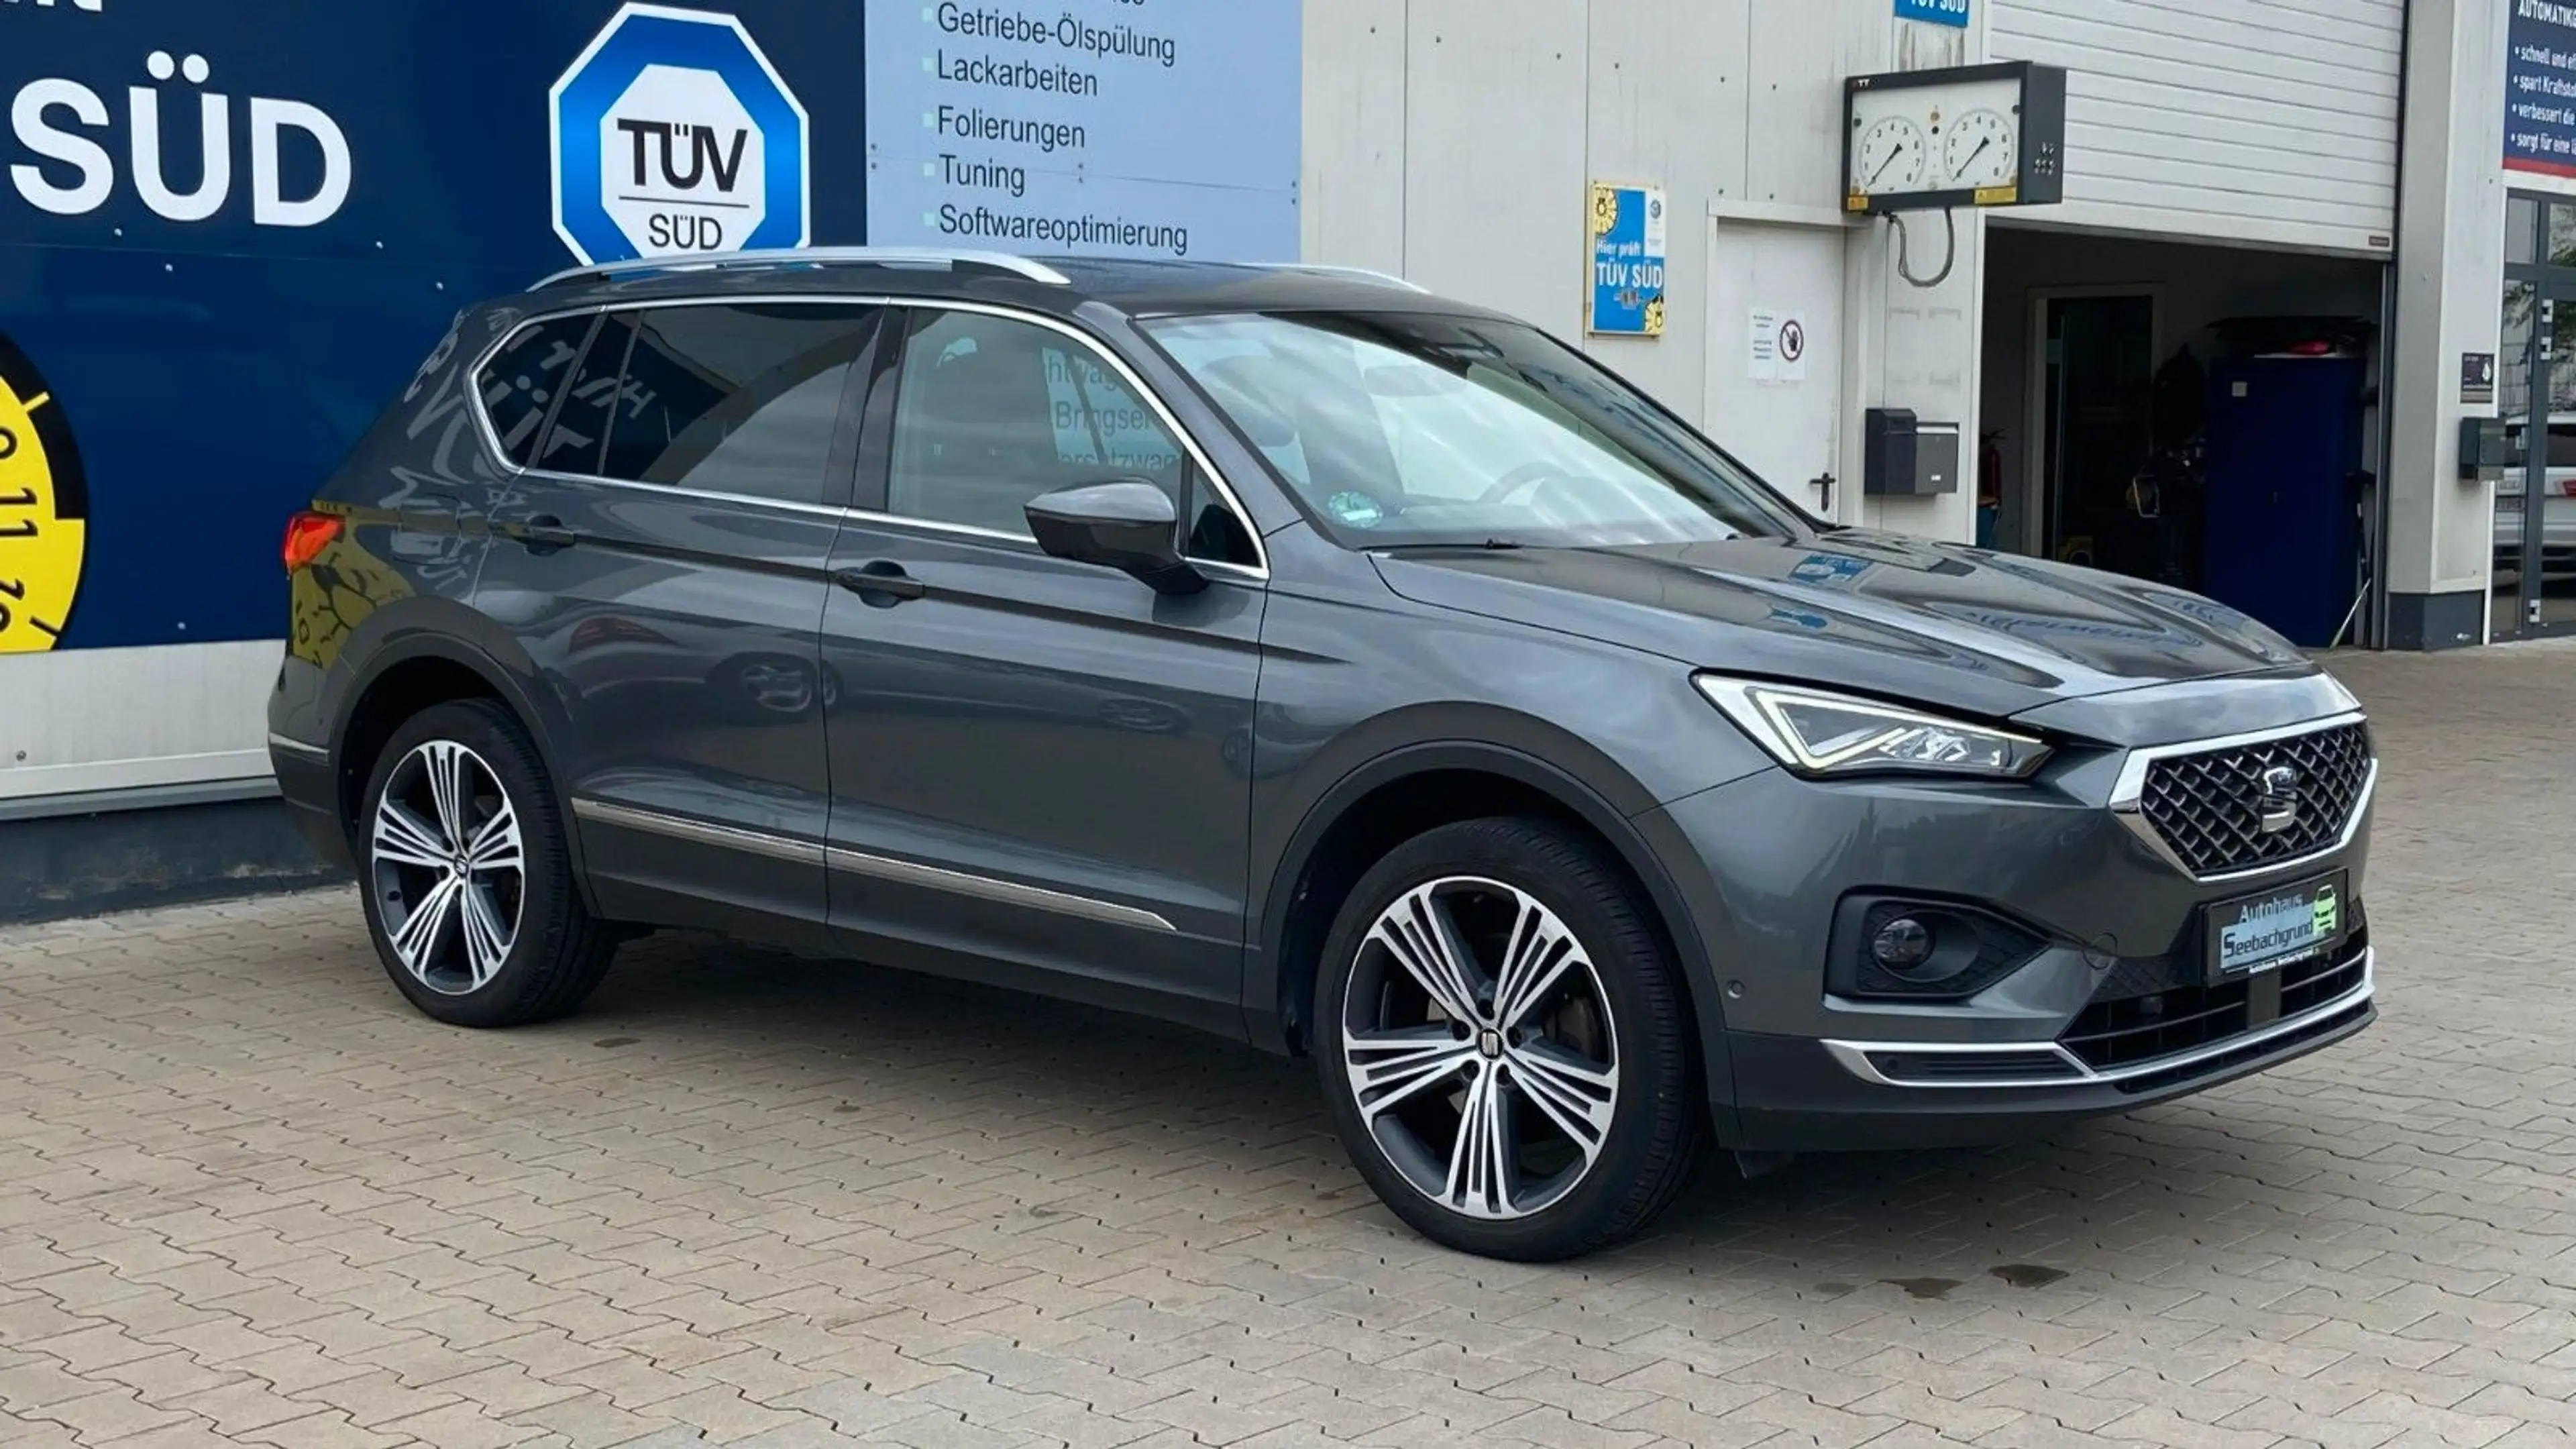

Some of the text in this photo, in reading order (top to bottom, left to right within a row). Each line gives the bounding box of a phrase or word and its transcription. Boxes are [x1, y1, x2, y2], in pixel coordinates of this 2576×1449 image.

[938, 2, 1176, 67] Getriebe-Ölspülung
[938, 49, 1098, 97] Lackarbeiten
[2551, 52, 2567, 68] und
[10, 50, 352, 227] SÜD
[938, 105, 1085, 152] Folierungen
[617, 118, 748, 193] TÜV
[940, 154, 1026, 197] Tuning
[648, 213, 722, 251] SÜD
[940, 203, 1188, 256] Softwareoptimierung
[1597, 239, 1641, 259] Hier prüft
[1597, 257, 1662, 288] TÜV SÜD
[2239, 893, 2304, 923] Autohaus
[2223, 920, 2313, 959] Seebachgrund
